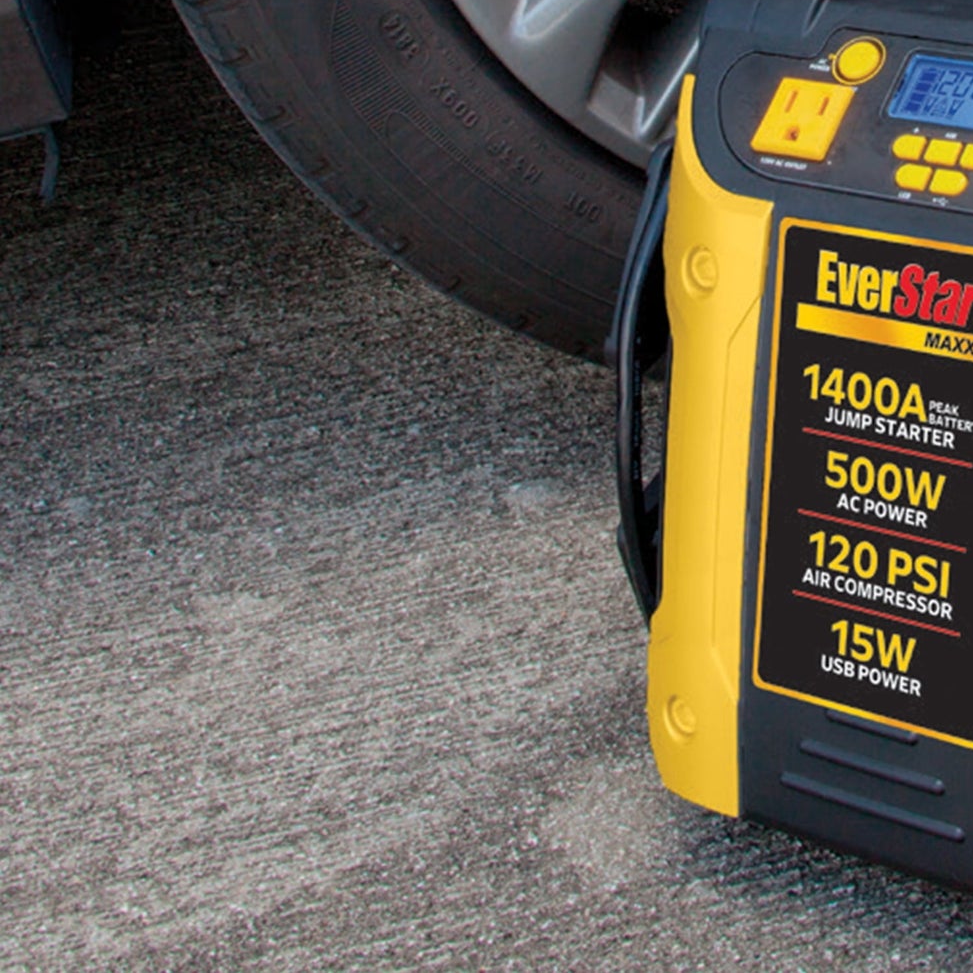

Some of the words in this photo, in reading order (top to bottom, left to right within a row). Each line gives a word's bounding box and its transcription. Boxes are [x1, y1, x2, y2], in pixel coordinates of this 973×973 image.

[803, 363, 928, 423] 1400A
[928, 400, 960, 417] PEAK
[824, 406, 872, 431] JUMP
[874, 415, 956, 449] STARTER
[824, 450, 947, 511] 500W
[836, 493, 861, 513] AC
[863, 498, 928, 528] POWER
[808, 530, 879, 579] 120
[887, 548, 951, 599] PSI
[802, 568, 831, 589] AIR
[834, 573, 953, 620] COMPRESSOR
[830, 619, 917, 674] 15W
[820, 654, 856, 677] USB
[857, 663, 922, 697] POWER
